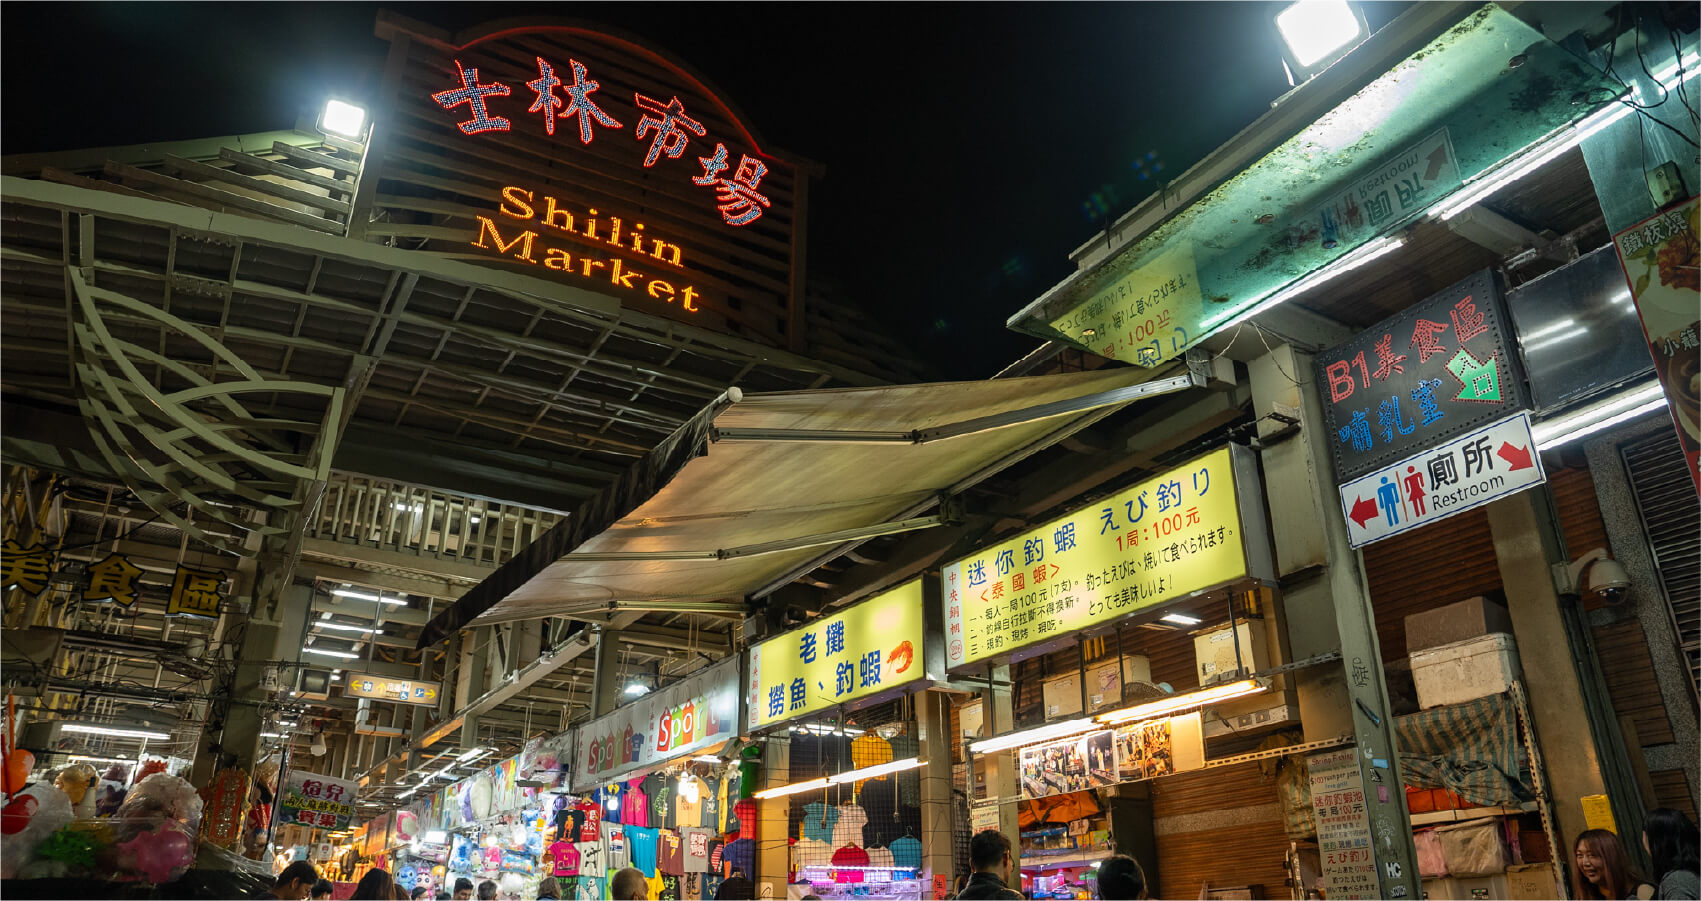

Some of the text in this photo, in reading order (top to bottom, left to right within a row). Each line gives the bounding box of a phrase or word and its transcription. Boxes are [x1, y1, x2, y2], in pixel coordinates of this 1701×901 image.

[431, 56, 771, 226] 士林市場
[499, 185, 685, 269] Shilin
[470, 215, 700, 313] Market
[1325, 295, 1489, 404] B1美食區
[1459, 355, 1495, 398] 入口
[1338, 377, 1446, 453] 哺乳室
[1427, 435, 1495, 493] 廁所
[1431, 473, 1505, 512] Restroom
[967, 467, 1210, 589] 迷你釣蝦 えび釣り
[799, 620, 845, 665] 老攤
[768, 649, 882, 719] 撈魚、釣蝦
[1327, 849, 1369, 865] えび釣り
[1386, 862, 1402, 880] HC
